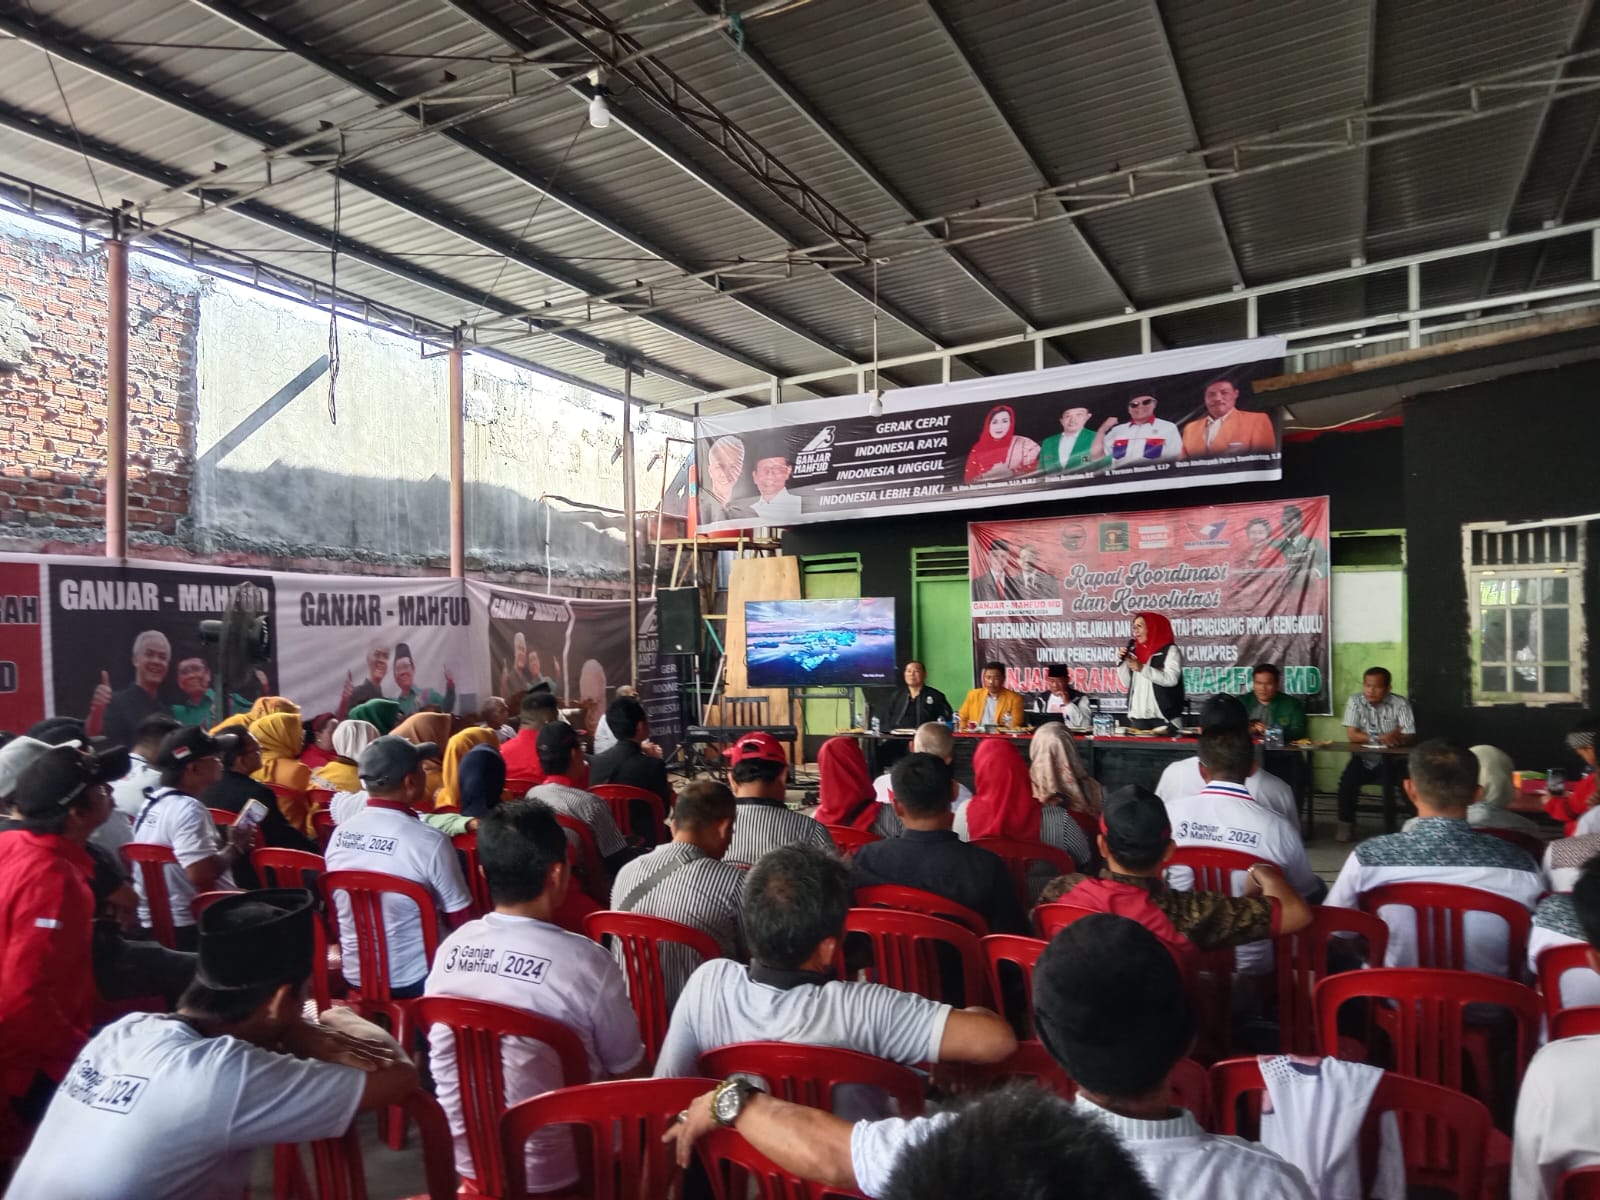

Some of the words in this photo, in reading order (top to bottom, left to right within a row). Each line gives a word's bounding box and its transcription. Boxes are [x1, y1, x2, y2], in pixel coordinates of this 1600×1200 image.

[876, 420, 914, 434] GERAK
[915, 415, 951, 429] CEPAT
[855, 441, 915, 457] INDONESIA
[917, 437, 948, 450] RAYA
[794, 462, 829, 474] MAHFUD
[796, 453, 831, 465] GANJAR
[836, 465, 895, 480] INDONESIA
[898, 460, 945, 474] UNGGUL
[820, 491, 877, 506] INDONESIA
[880, 489, 911, 500] LEBIH
[913, 484, 945, 497] BAIK!
[1065, 564, 1123, 592] Rapat
[1125, 561, 1228, 588] Koordinasi
[60, 579, 160, 611] GANJAR
[1072, 593, 1106, 612] dan
[1109, 588, 1221, 614] Konsolidasi
[301, 592, 382, 626] GANJAR
[398, 596, 471, 626] MAHFUD
[977, 623, 989, 639] TIM
[991, 622, 1040, 640] PEMENANGAN
[1041, 621, 1074, 641] DAERAH,
[1075, 621, 1113, 638] RELAWAN
[1114, 620, 1131, 637] DAN
[1191, 617, 1245, 636] PENGUSUNG
[1246, 616, 1272, 635] PROV.
[1273, 615, 1323, 634] BENGKULU
[1036, 648, 1067, 663] UNTUK
[1068, 647, 1120, 662] PEMENANGA
[1187, 645, 1239, 662] CAWAPRES
[1284, 666, 1322, 694] MD
[1180, 823, 1188, 837] 3
[1190, 831, 1223, 842] Mahfud
[1191, 822, 1219, 832] Ganjar
[369, 838, 394, 852] 2024
[1228, 830, 1257, 844] 2024
[446, 947, 458, 970] 3
[461, 945, 495, 960] Ganjar
[459, 959, 499, 974] Mahfud
[504, 955, 544, 979] 2024
